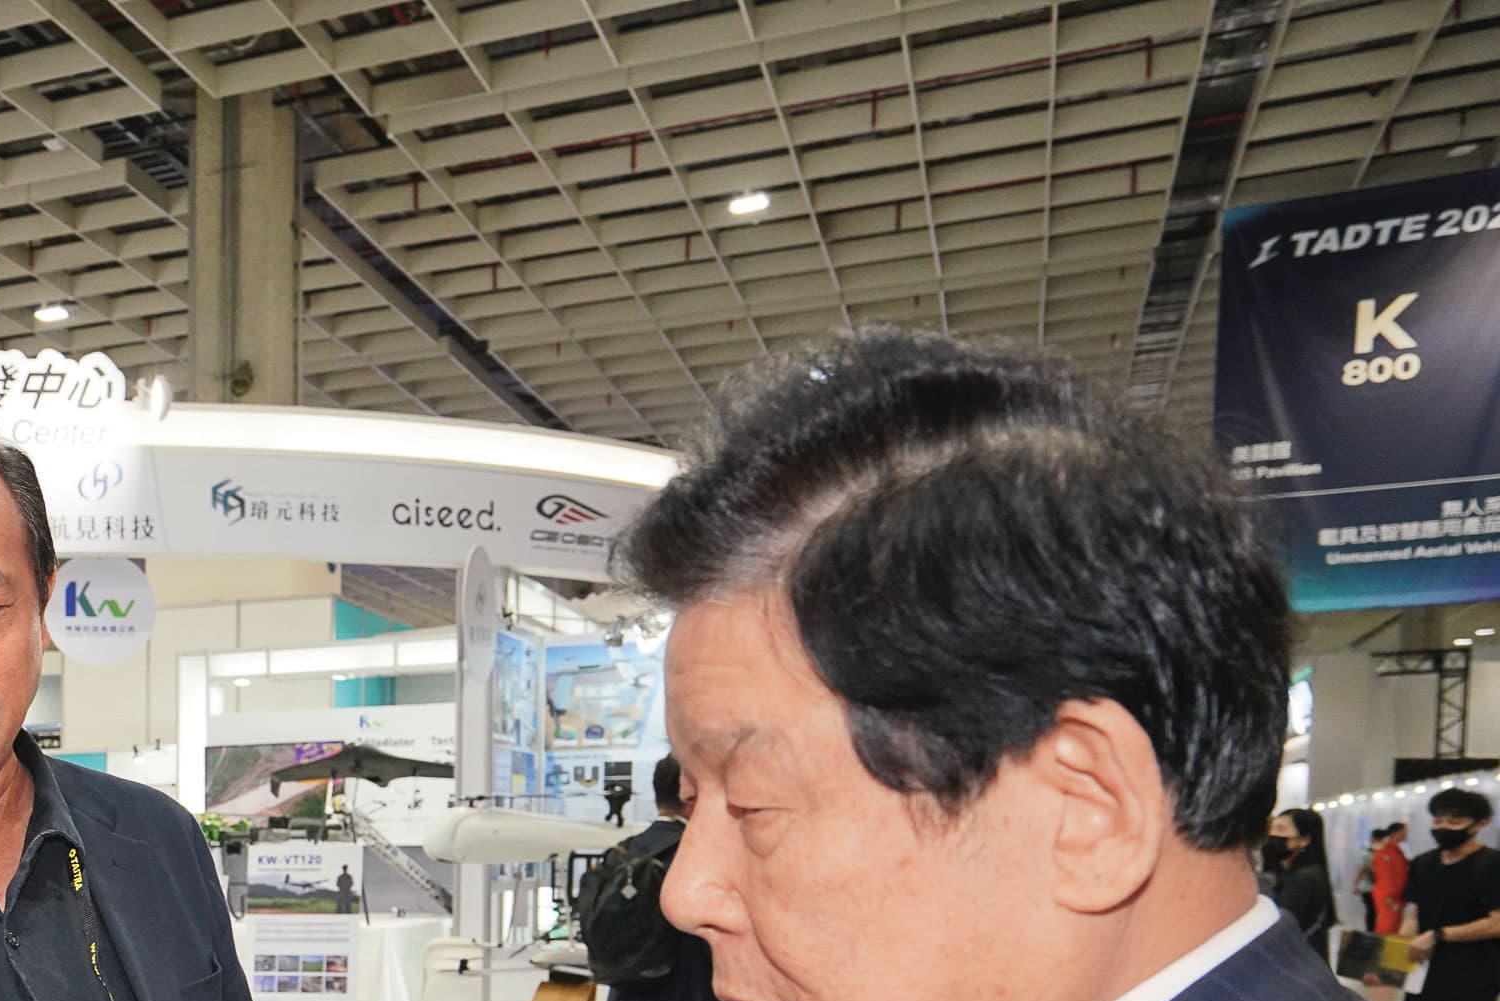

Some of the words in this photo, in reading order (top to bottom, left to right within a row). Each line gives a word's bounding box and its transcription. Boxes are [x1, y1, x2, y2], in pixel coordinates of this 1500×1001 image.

[1290, 213, 1431, 258] TADTE
[1354, 292, 1420, 354] K
[1341, 353, 1422, 386] 800
[392, 498, 502, 533] aiseed.
